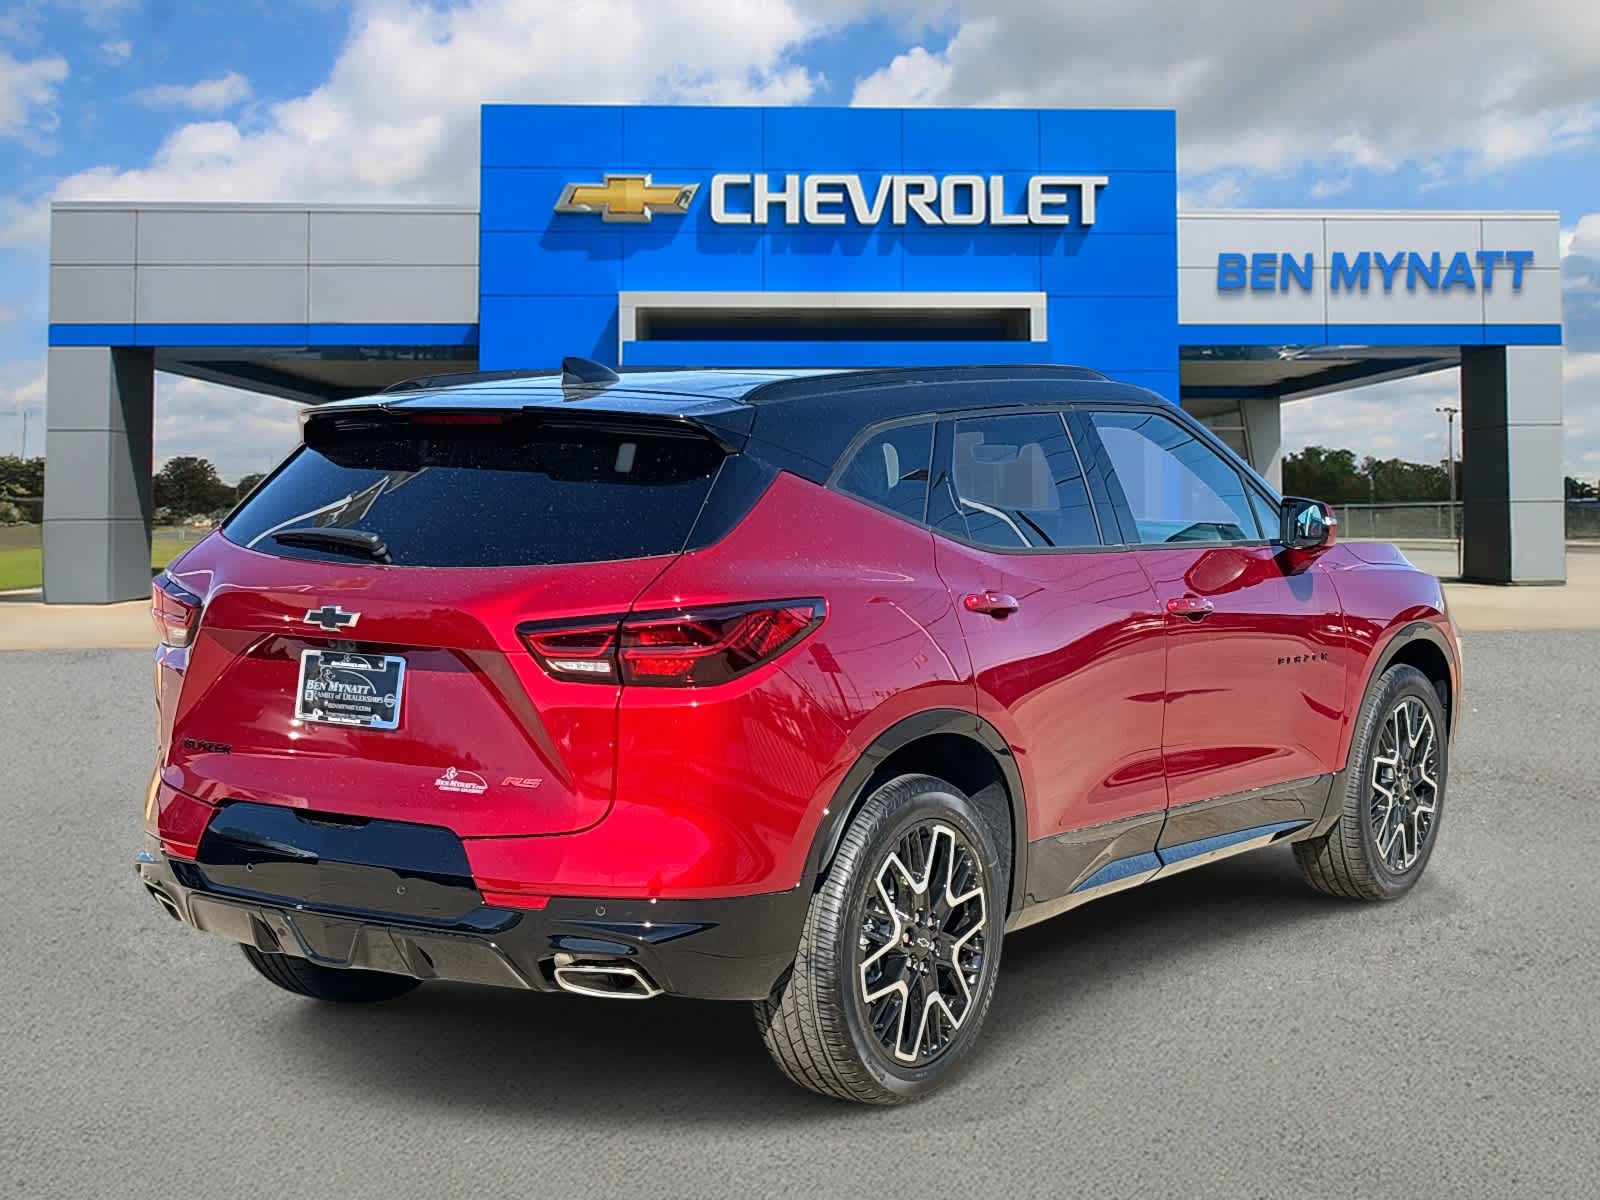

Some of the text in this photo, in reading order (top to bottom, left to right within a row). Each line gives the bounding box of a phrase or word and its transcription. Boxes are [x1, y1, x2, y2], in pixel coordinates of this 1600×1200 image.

[710, 173, 1109, 225] CHEVROLET
[1217, 250, 1534, 290] BEN MYNATT
[500, 776, 543, 789] RS
